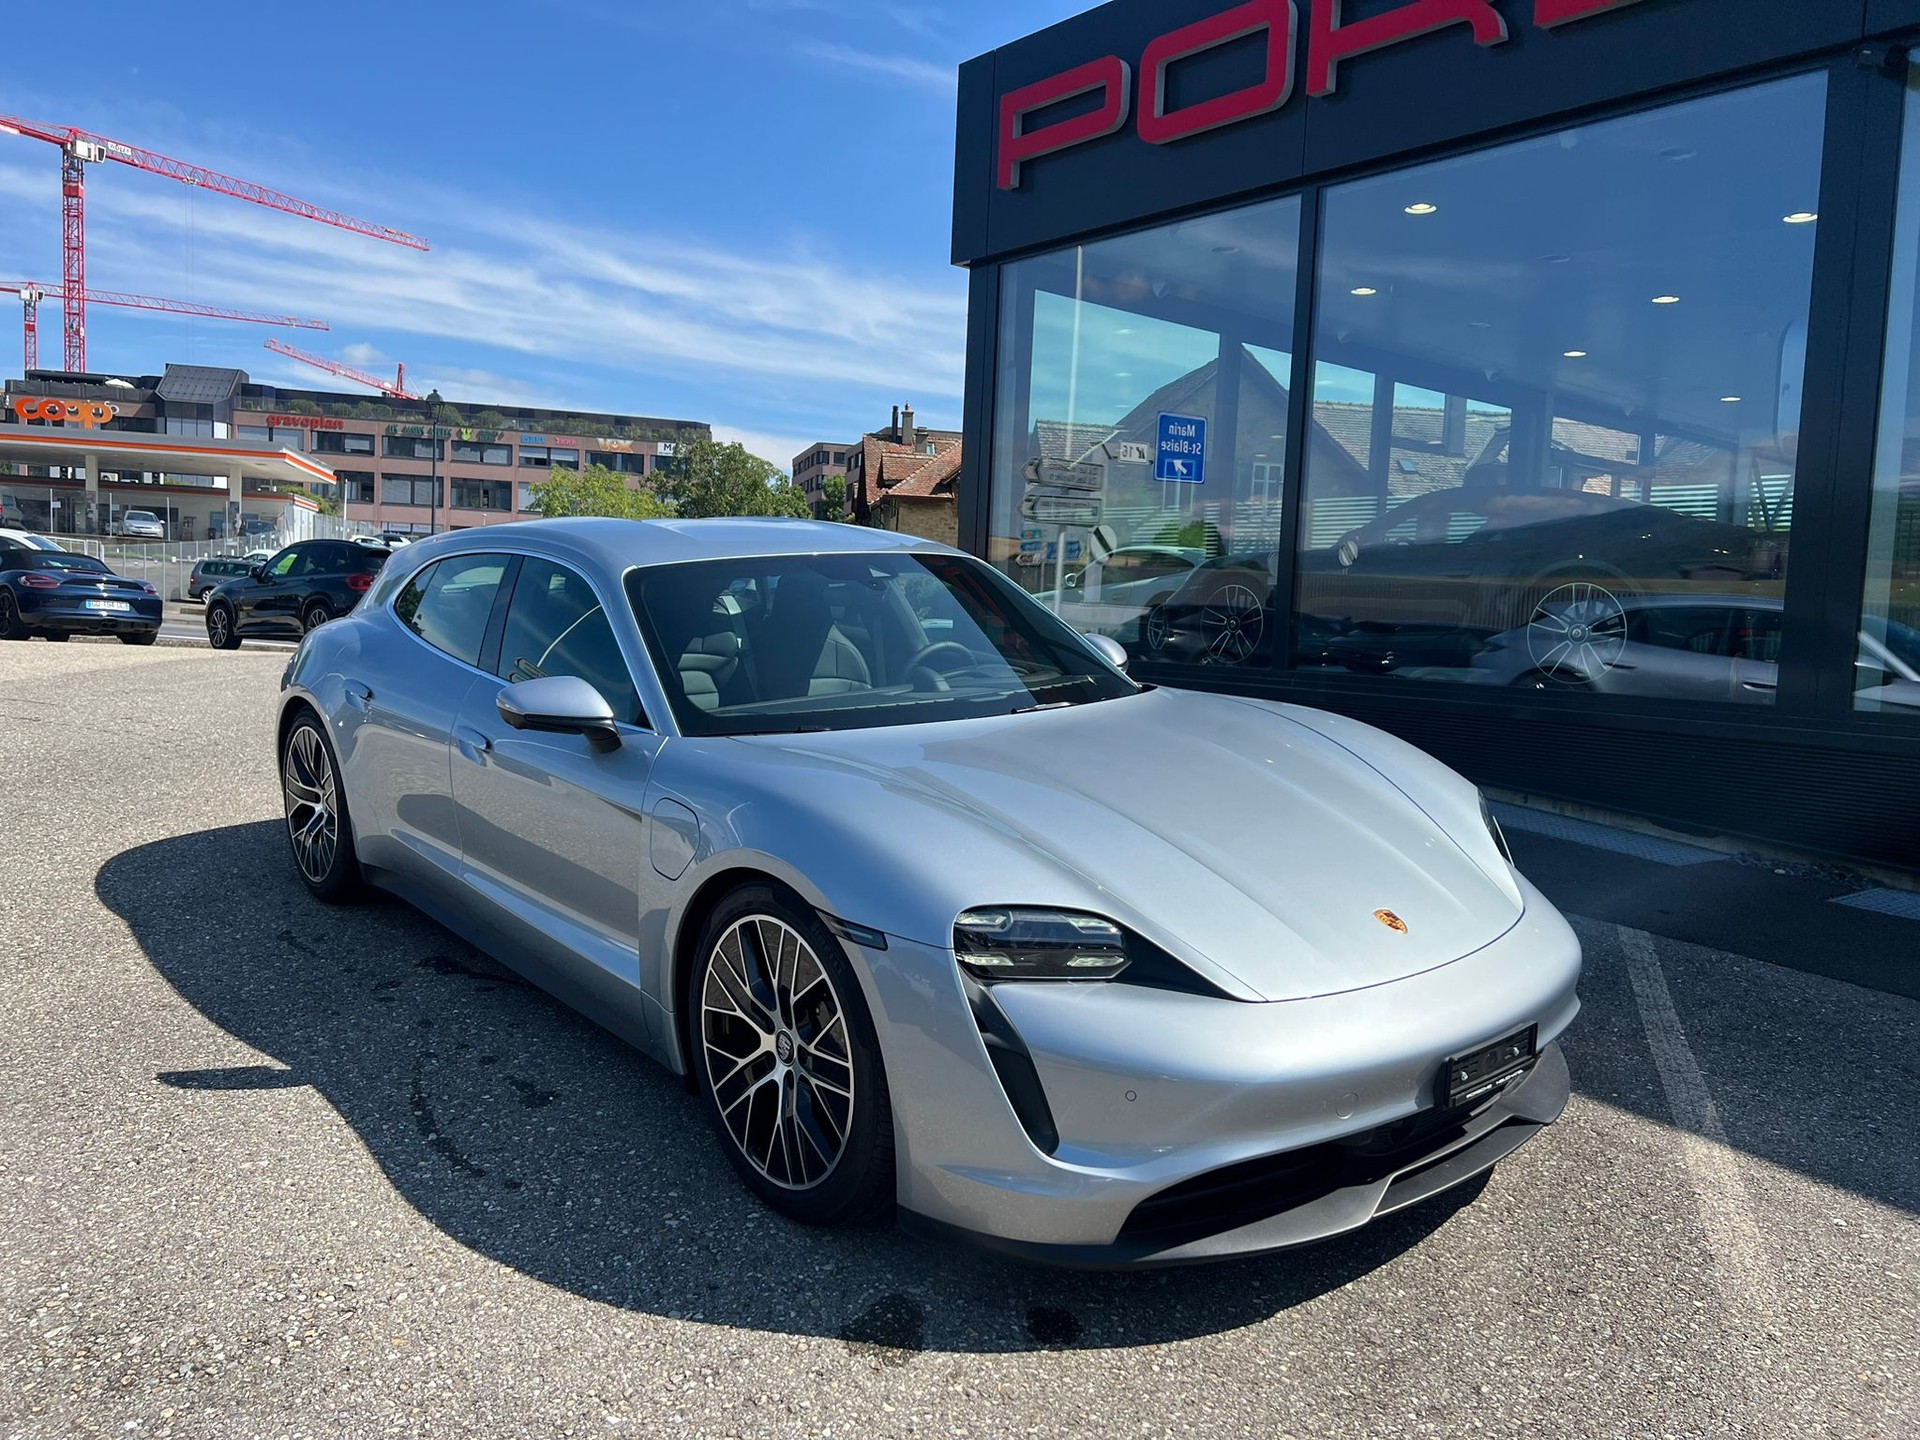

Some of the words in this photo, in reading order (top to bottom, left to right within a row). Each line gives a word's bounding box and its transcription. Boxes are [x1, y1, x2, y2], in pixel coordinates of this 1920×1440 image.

[996, 0, 1643, 190] POR
[14, 397, 113, 429] coop
[267, 414, 344, 430] gravoplan
